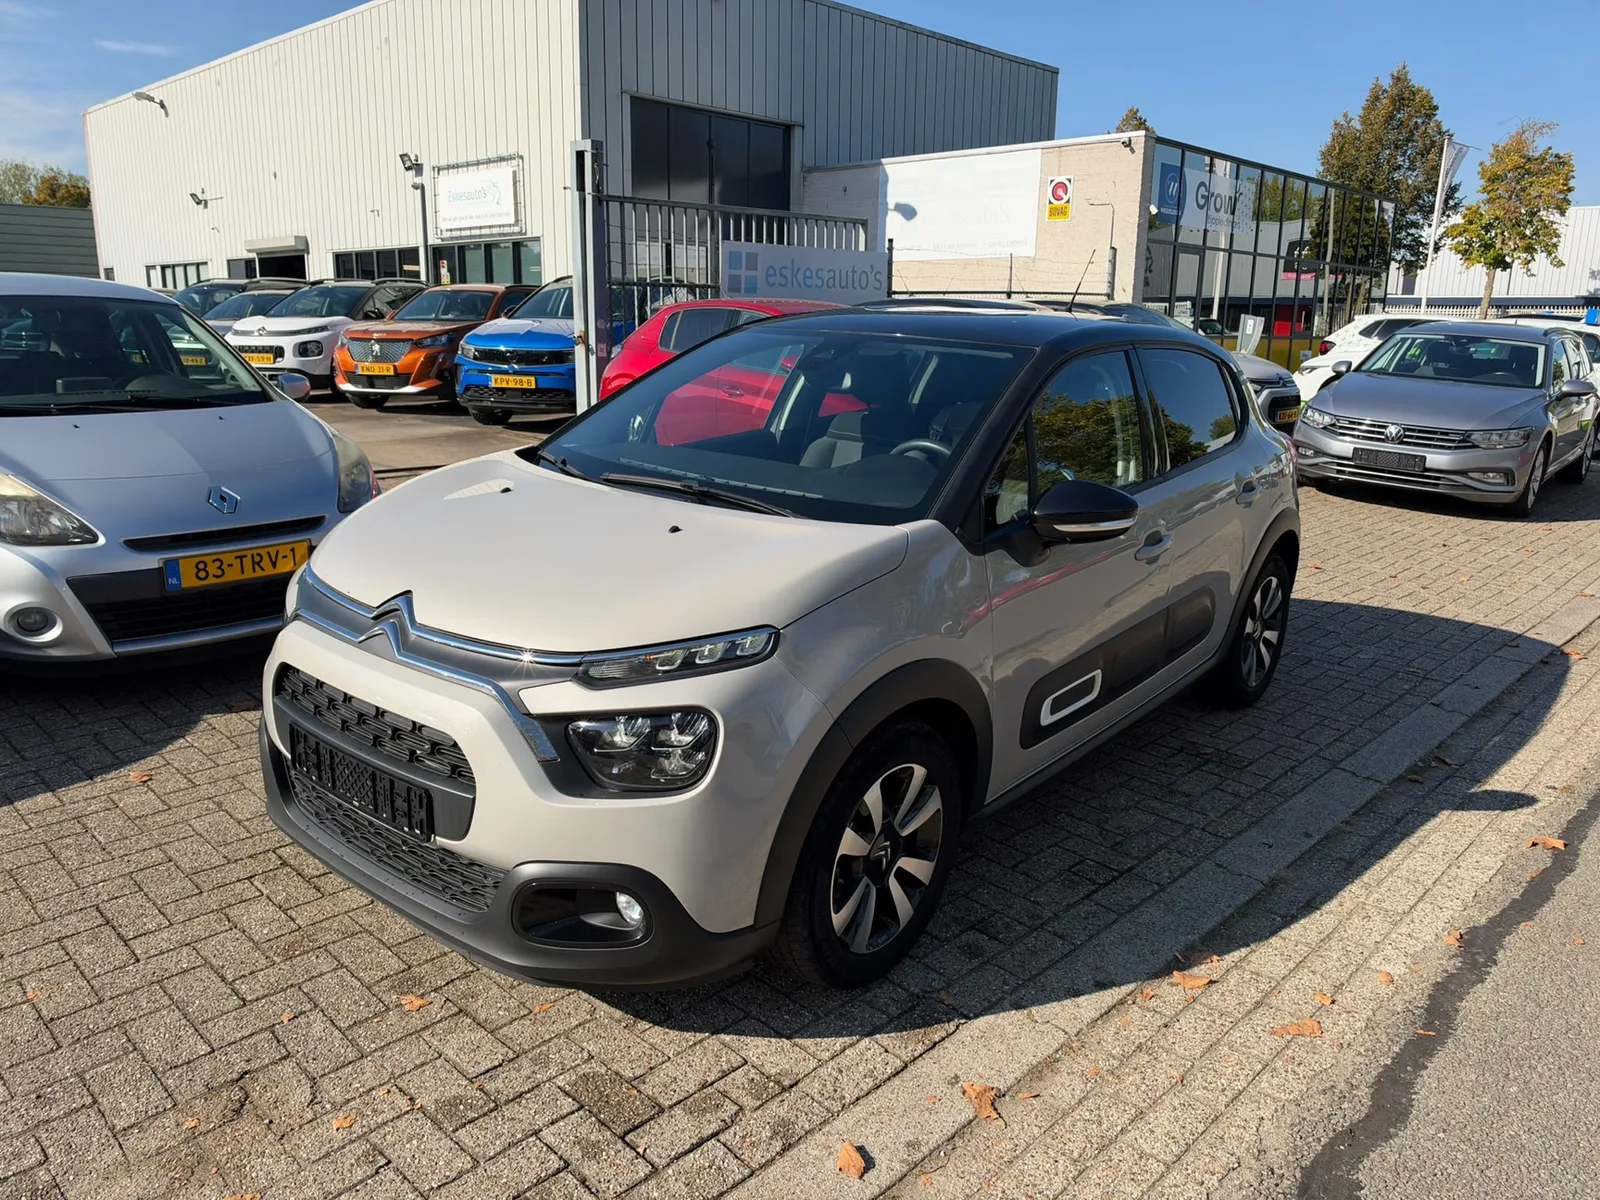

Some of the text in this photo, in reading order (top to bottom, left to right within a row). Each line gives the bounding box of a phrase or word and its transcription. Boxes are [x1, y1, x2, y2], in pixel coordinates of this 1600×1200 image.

[765, 258, 883, 291] eskesauto's
[494, 377, 533, 387] KPV-98-B
[194, 547, 297, 581] 83-TRV-1
